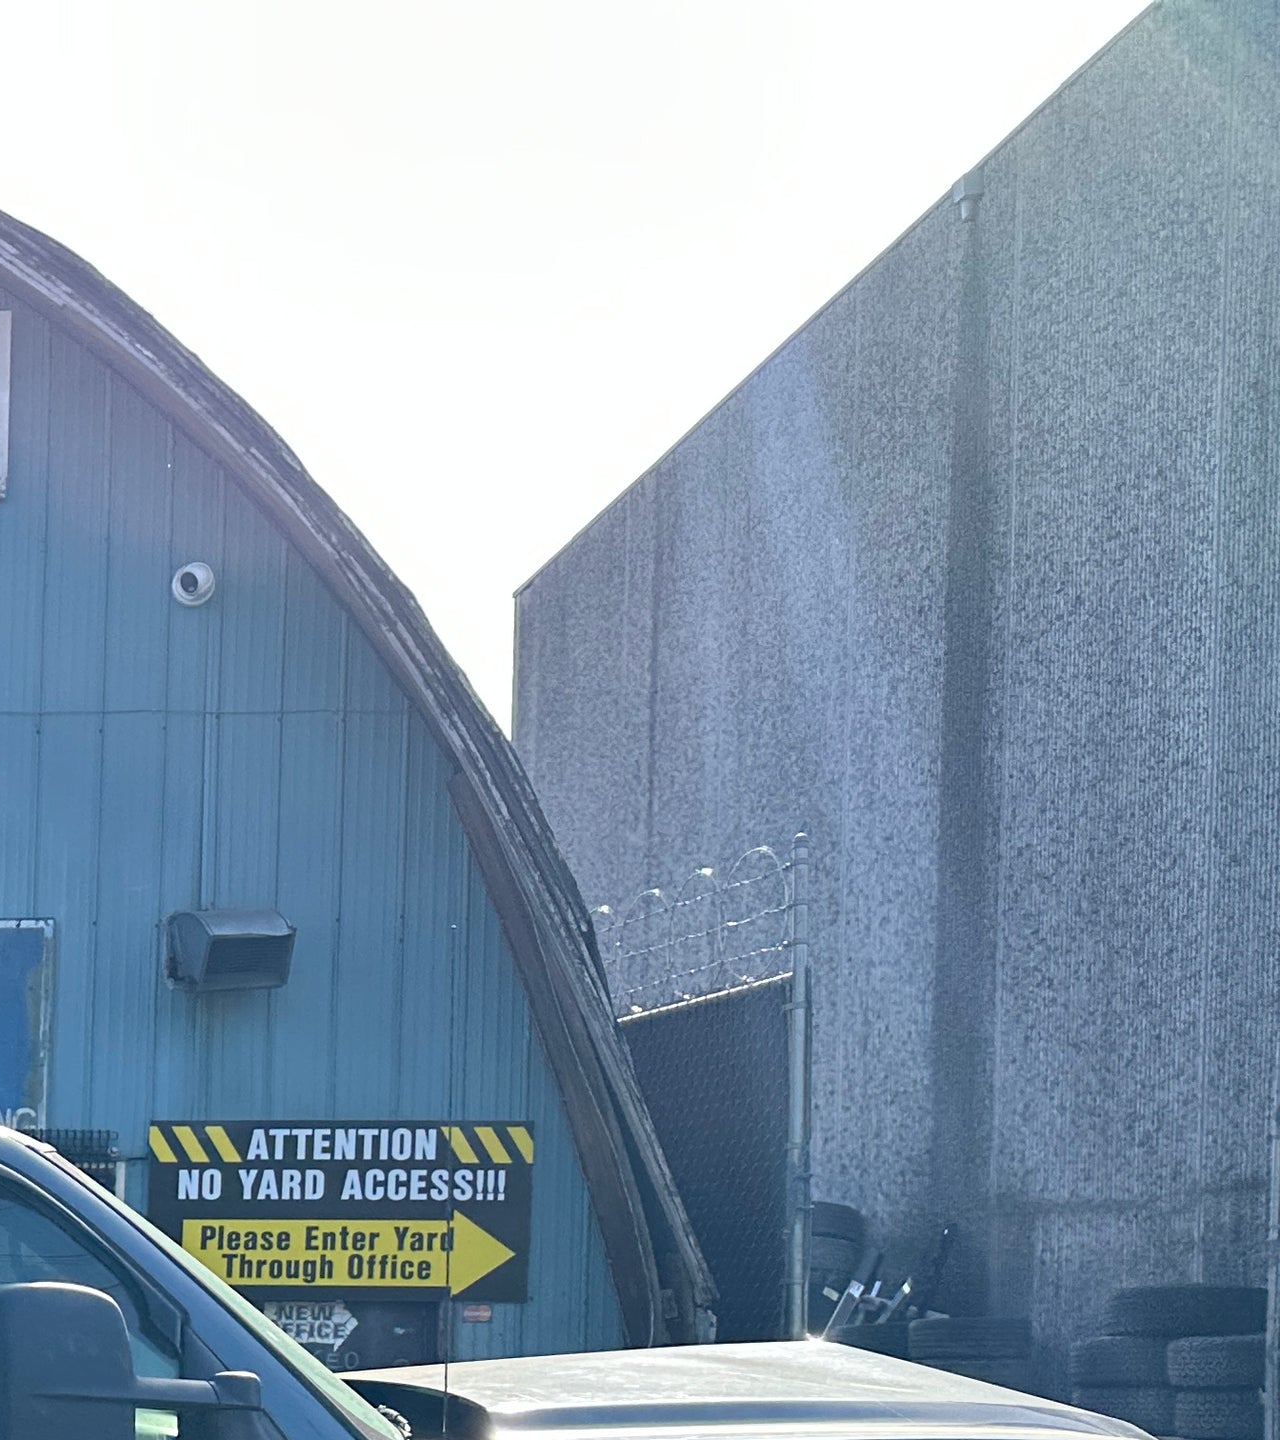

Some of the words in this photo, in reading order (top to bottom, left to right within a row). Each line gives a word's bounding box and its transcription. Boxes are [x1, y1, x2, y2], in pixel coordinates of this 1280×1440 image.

[246, 1127, 438, 1161] ATTENTION
[177, 1168, 223, 1201] NO
[238, 1168, 326, 1201] YARD
[340, 1168, 507, 1202] ACCESS!!!
[199, 1225, 292, 1252] Please
[304, 1225, 380, 1252] Enter
[393, 1226, 455, 1252] Yard
[221, 1253, 334, 1283] Through
[347, 1254, 432, 1281] Office
[276, 1304, 333, 1321] NEW
[278, 1321, 347, 1339] FFICE
